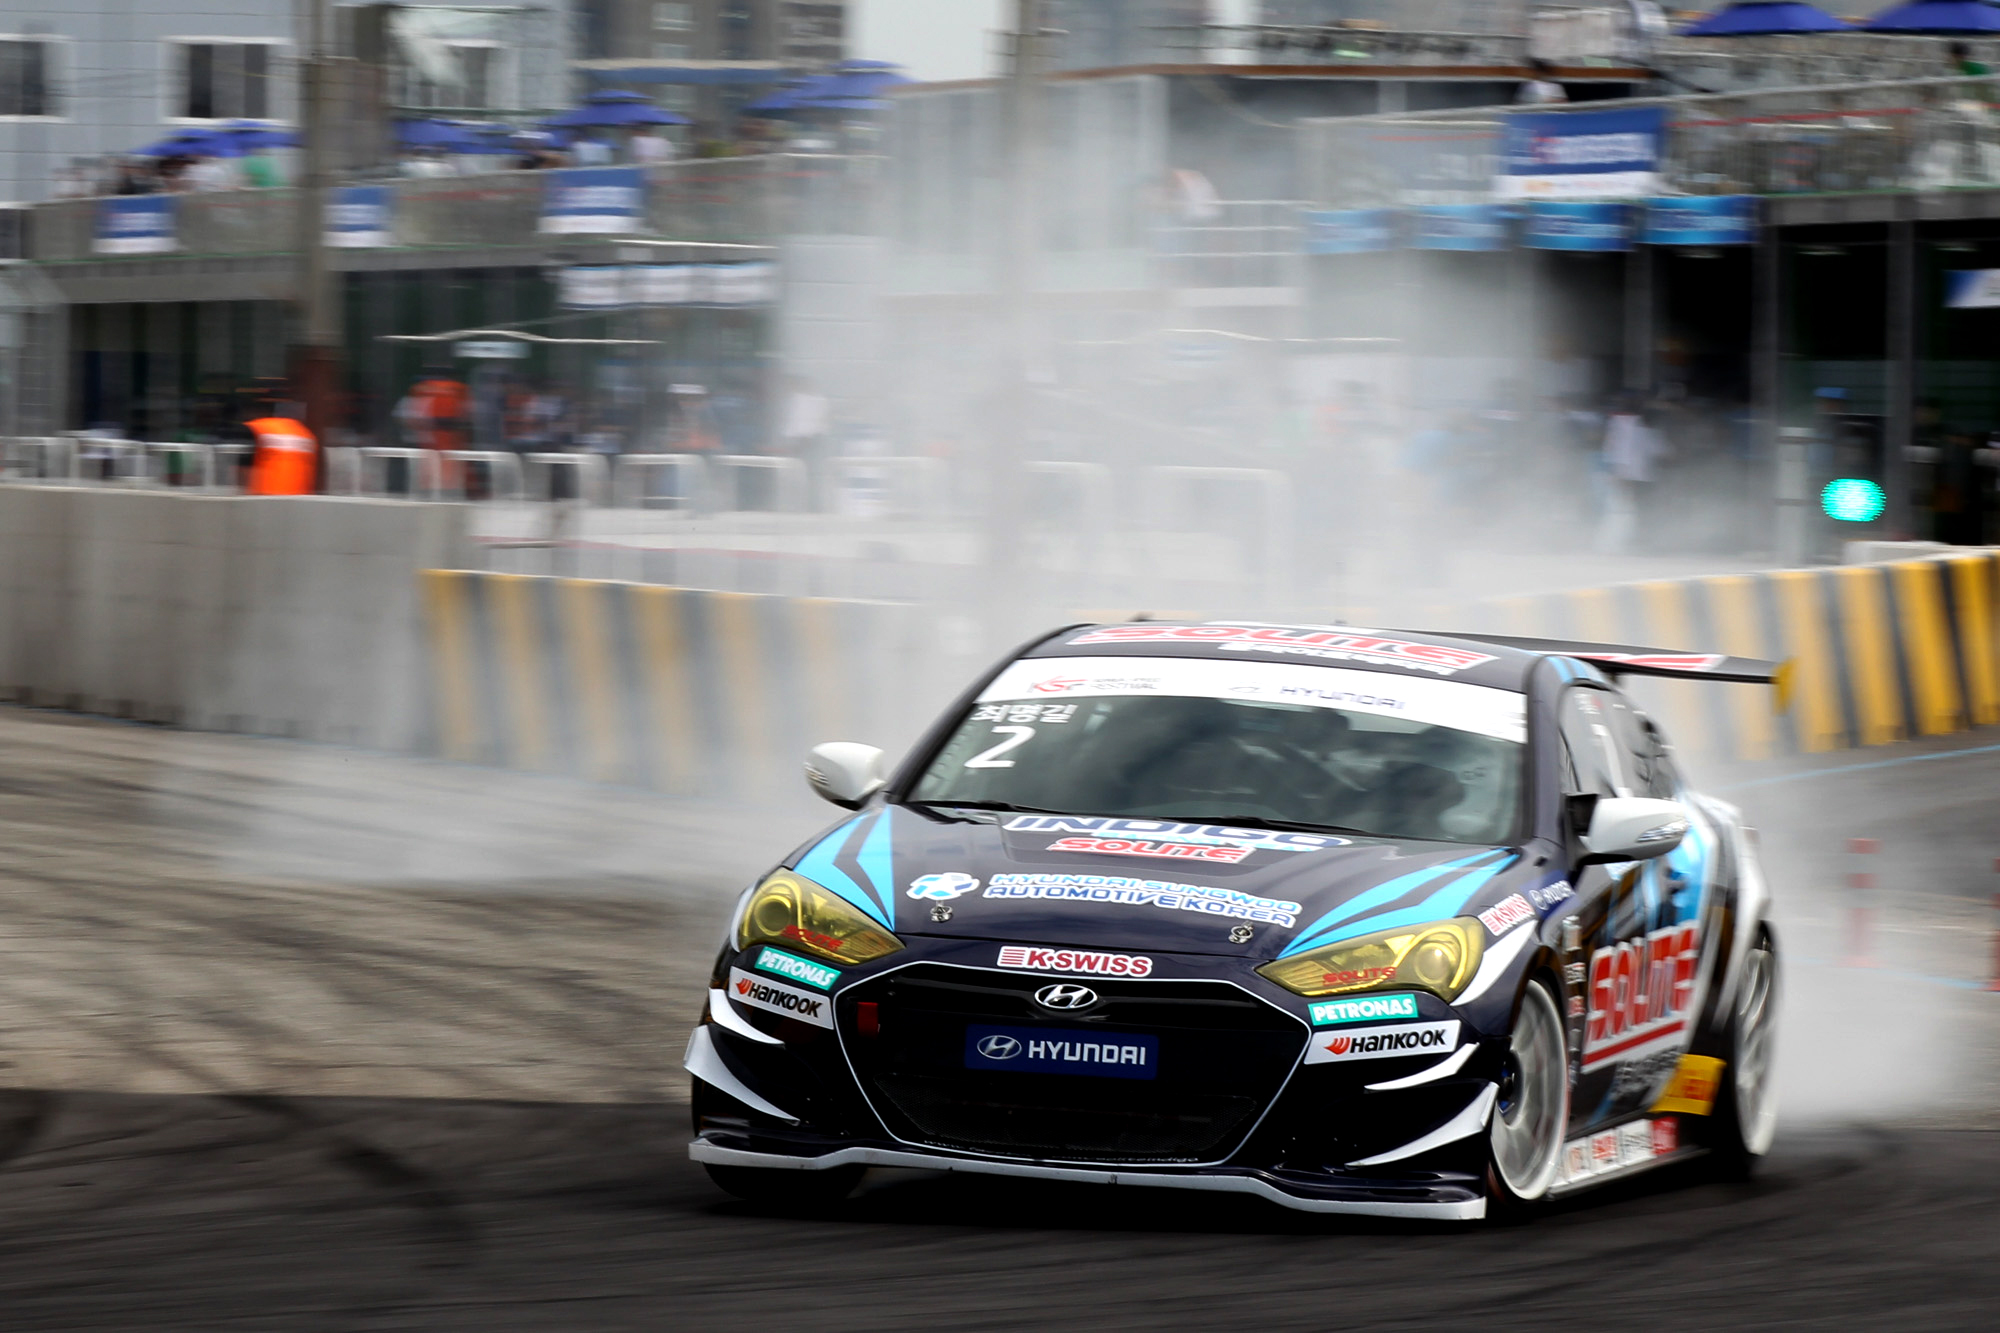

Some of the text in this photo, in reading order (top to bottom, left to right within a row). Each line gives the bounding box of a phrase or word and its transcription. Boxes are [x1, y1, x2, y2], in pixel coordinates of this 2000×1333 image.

[1080, 625, 1492, 667] SOLITE
[1280, 685, 1405, 709] HYUNDAI
[963, 725, 1037, 769] 2
[1010, 815, 1346, 848] INDIGO
[1055, 837, 1251, 862] SOLITE
[986, 885, 1294, 926] AUTOMOTIVE KOREA
[757, 950, 836, 988] PETRONAS
[1321, 966, 1398, 986] SOLITE
[1588, 922, 1700, 1042] SOLITE
[1313, 997, 1414, 1023] PETRONAS
[1028, 1040, 1147, 1067] HYUNDAI
